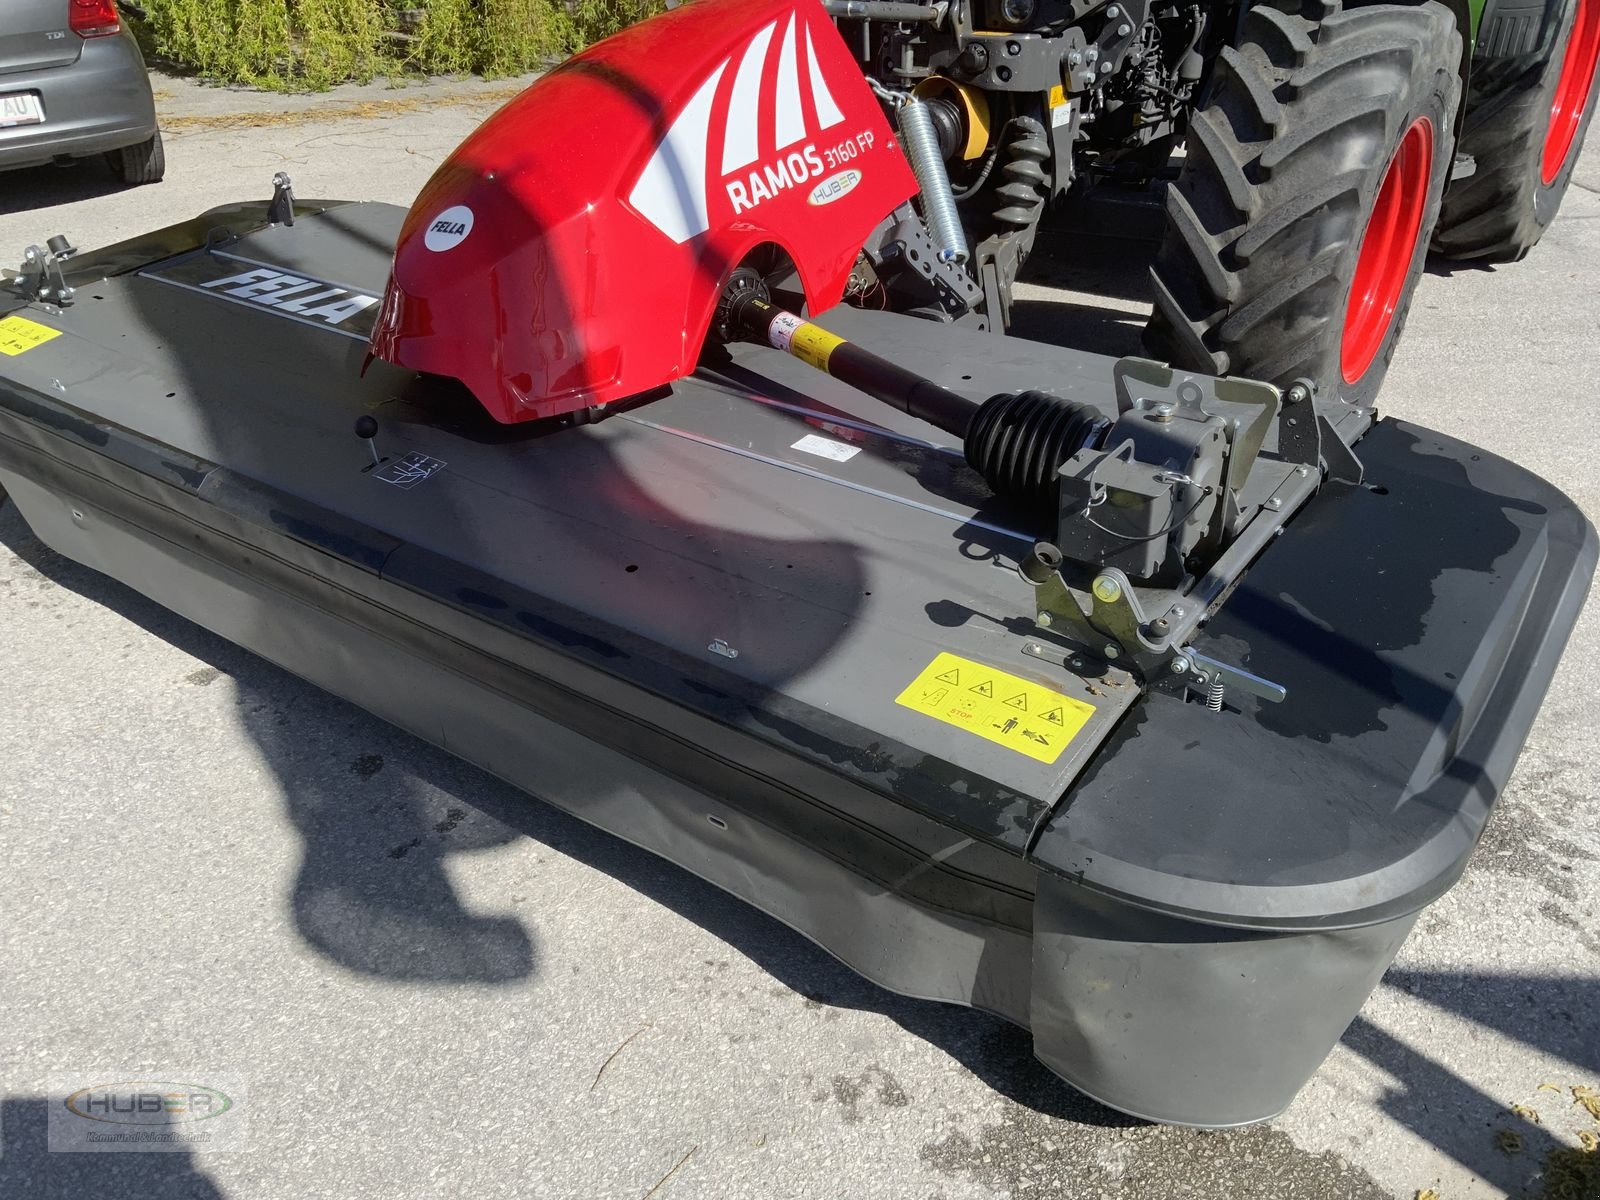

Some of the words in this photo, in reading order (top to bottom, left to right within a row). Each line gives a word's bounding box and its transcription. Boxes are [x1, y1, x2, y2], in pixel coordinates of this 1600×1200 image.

[725, 144, 825, 215] RAMOS
[824, 140, 858, 169] 3160
[856, 130, 875, 153] FP
[813, 172, 858, 203] HUBER
[430, 220, 466, 236] FELLA
[200, 268, 379, 324] FELLA
[950, 708, 972, 719] STOP
